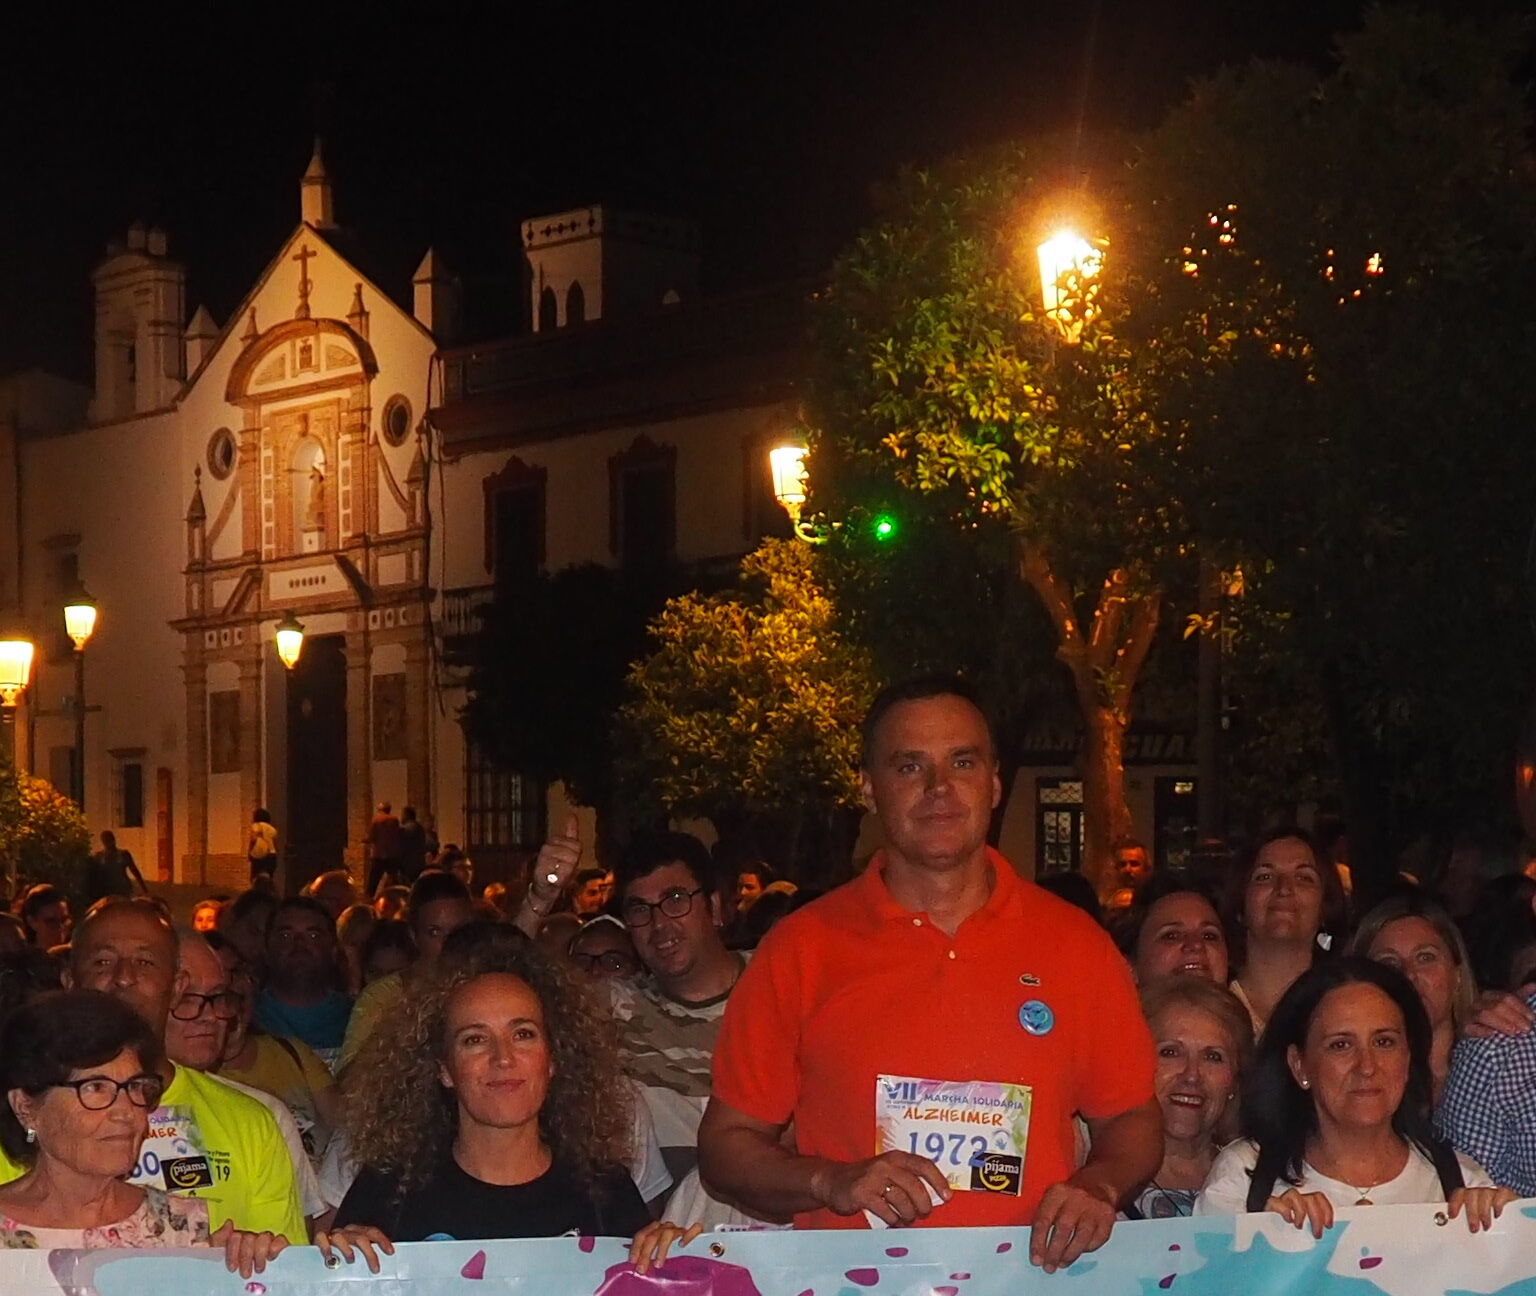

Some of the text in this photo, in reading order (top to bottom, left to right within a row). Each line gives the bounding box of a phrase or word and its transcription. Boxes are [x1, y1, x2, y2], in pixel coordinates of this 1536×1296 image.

[883, 1082, 918, 1101] VII
[923, 1093, 969, 1105] MARCHA
[972, 1096, 1024, 1111] SOLIDARIA
[903, 1107, 1004, 1127] ALZHEIMER
[909, 1132, 989, 1168] 1972
[173, 1162, 208, 1177] pijama
[984, 1160, 1020, 1176] pijama
